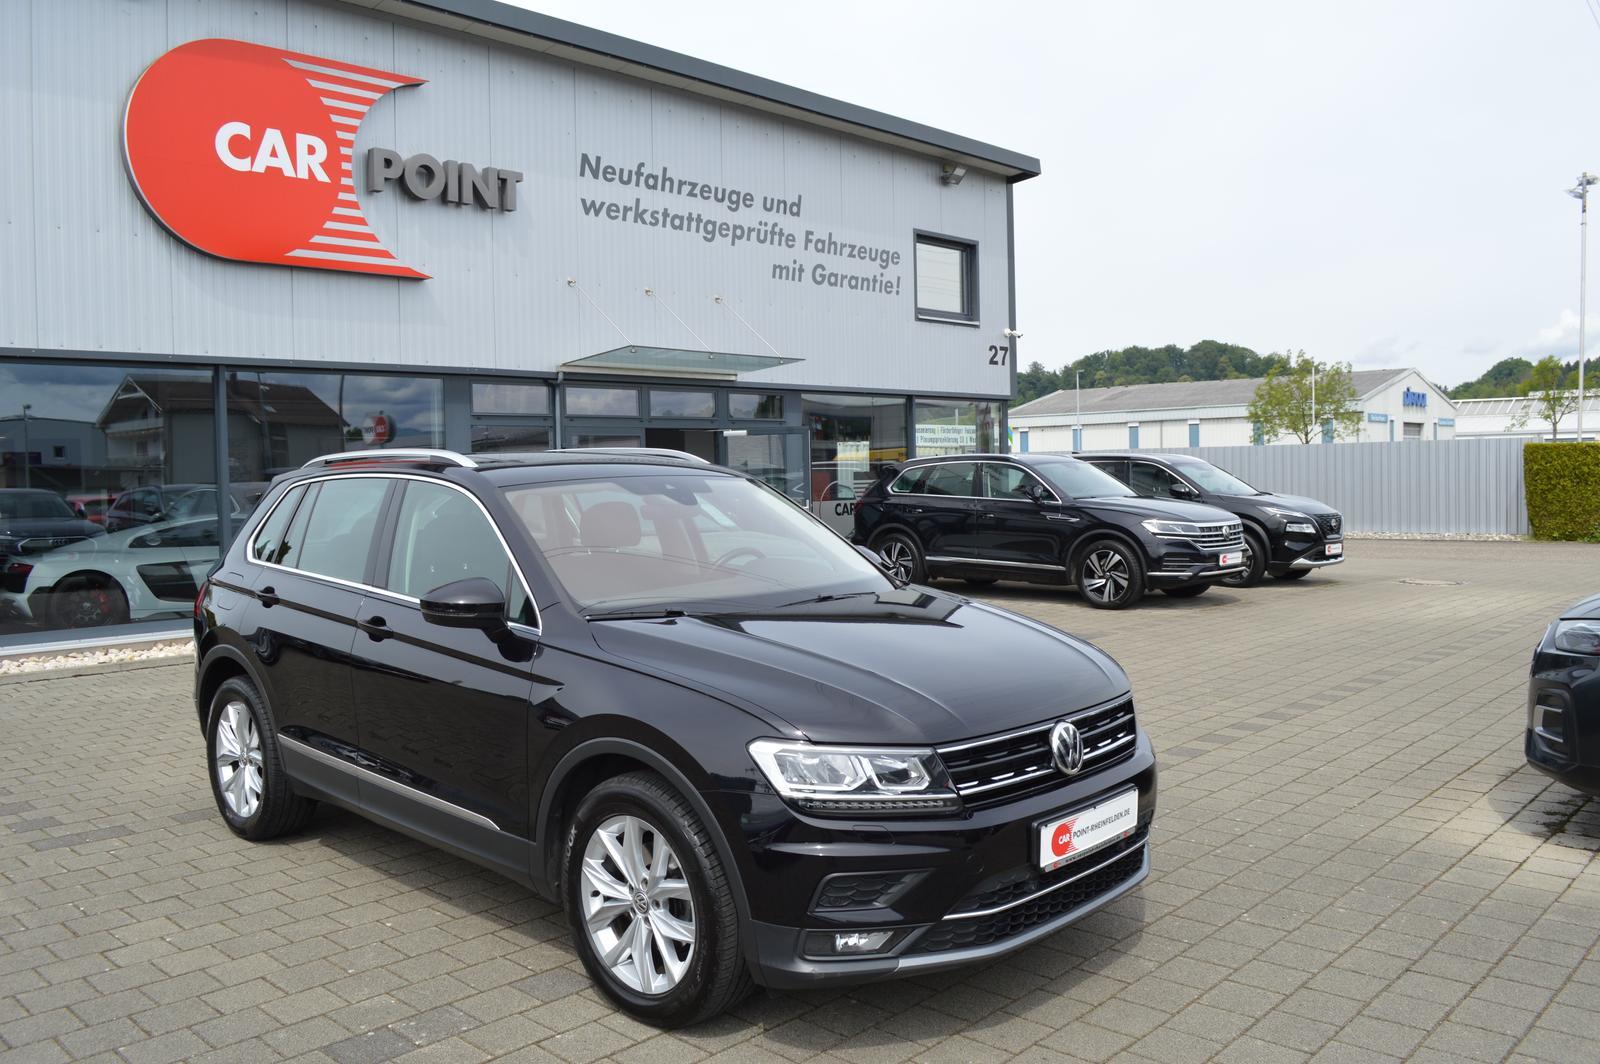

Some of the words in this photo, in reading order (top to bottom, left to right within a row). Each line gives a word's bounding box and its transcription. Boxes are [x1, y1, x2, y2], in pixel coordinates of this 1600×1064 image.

[215, 121, 331, 183] CAR
[368, 147, 524, 212] POINT
[579, 152, 754, 212] Neufahrzeuge
[762, 194, 802, 217] und
[580, 197, 796, 247] werkstattgeprüfte
[804, 230, 901, 268] Fahrzeuge
[771, 259, 805, 282] mit
[811, 263, 901, 296] Garantie!
[988, 345, 1009, 366] 27
[1058, 833, 1070, 845] CAR
[1072, 807, 1131, 839] POINT-RHEINFELDEN.DE
